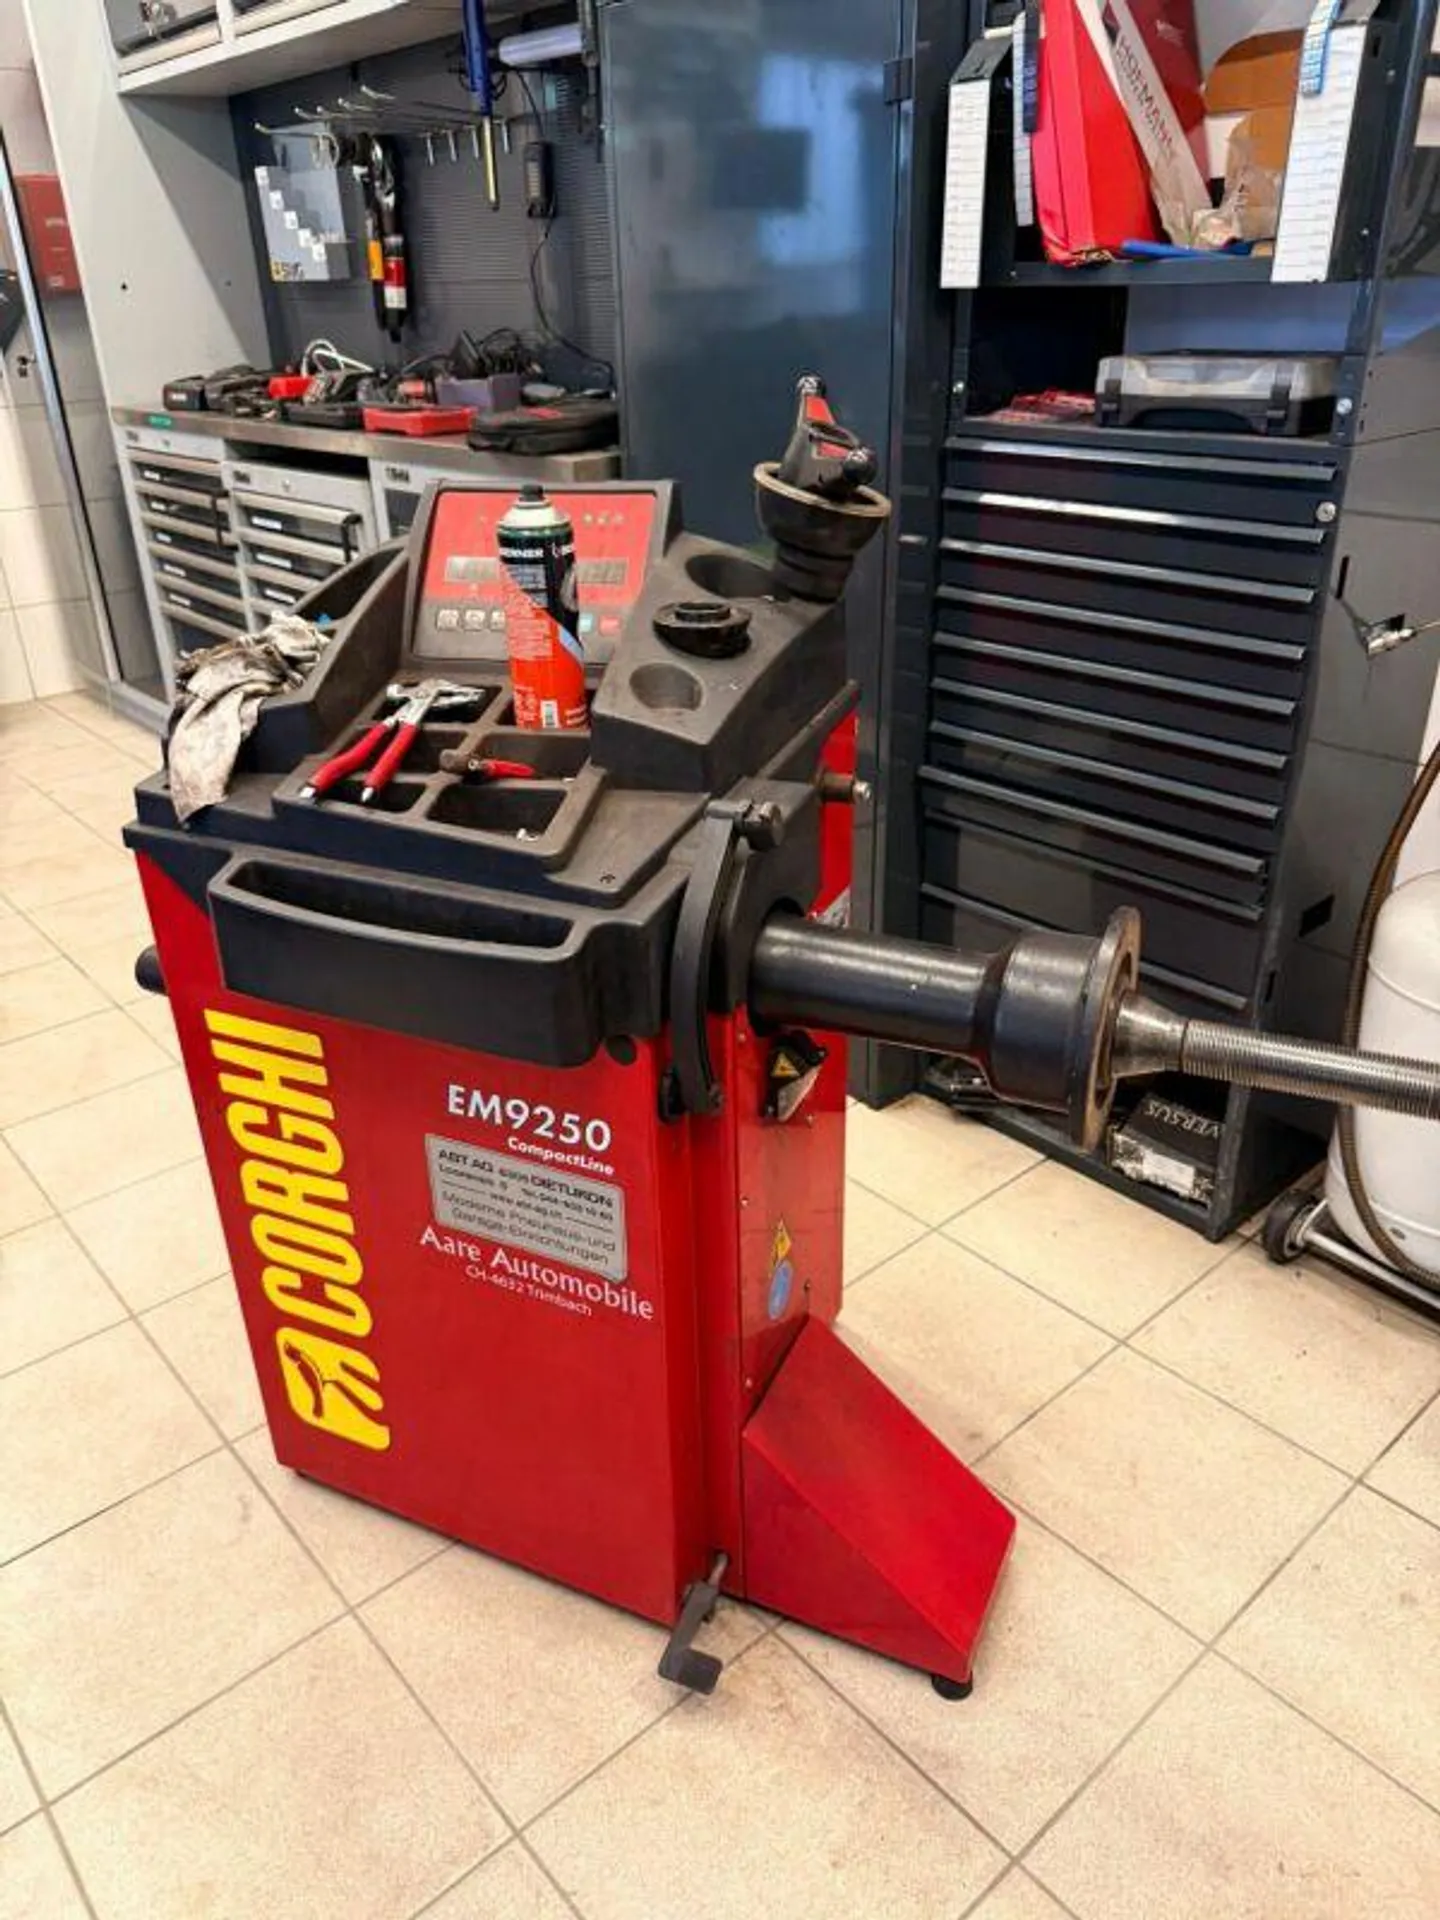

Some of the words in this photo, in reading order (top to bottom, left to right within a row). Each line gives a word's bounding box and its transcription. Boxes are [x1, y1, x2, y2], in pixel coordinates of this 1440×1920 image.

[448, 1084, 612, 1152] EM9250
[1144, 1099, 1220, 1139] VERSUS
[203, 1008, 373, 1337] CORGHI
[507, 1136, 614, 1176] CompactLine
[419, 1225, 482, 1262] Aare
[491, 1247, 654, 1320] Automobile
